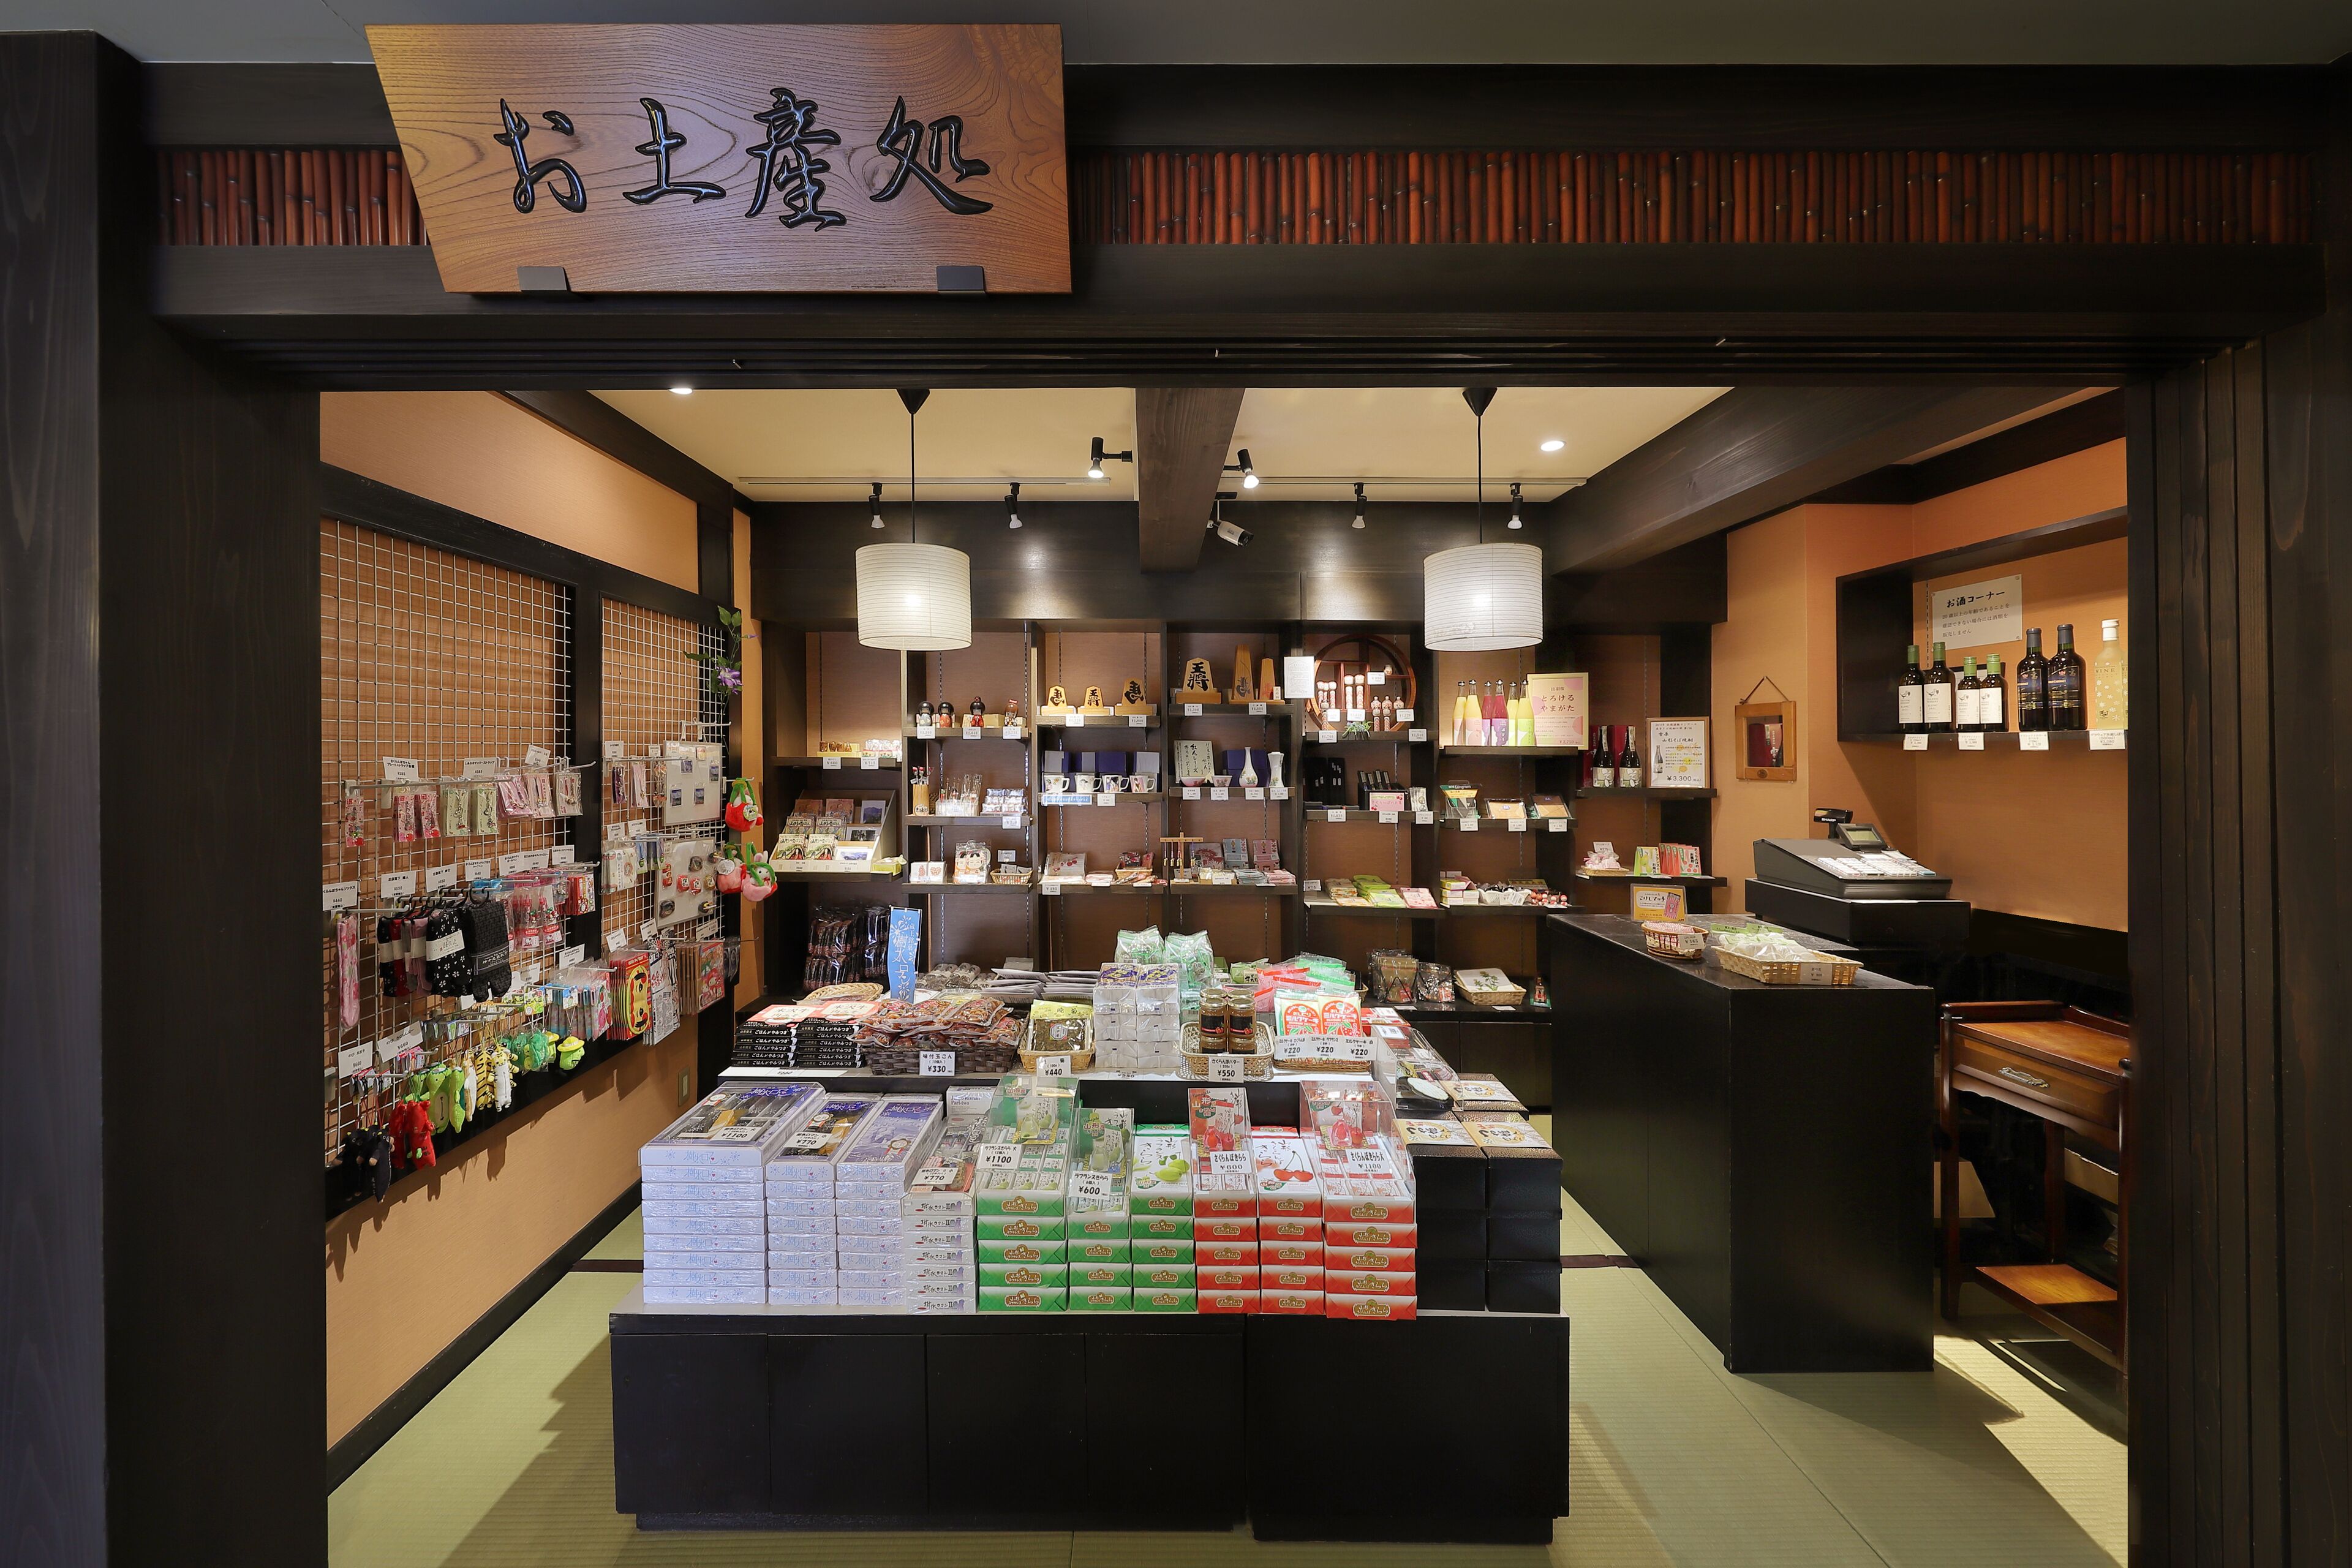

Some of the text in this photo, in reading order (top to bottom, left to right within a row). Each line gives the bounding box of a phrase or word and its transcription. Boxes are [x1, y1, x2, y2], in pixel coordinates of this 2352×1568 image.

[492, 87, 993, 233] お土産処
[1947, 591, 2005, 608] お酒コーナー
[398, 1041, 409, 1050] ¥660
[1214, 1153, 1246, 1163] さくらんぼきらら
[1351, 1152, 1385, 1161] さくらんぼきらら大
[1078, 1186, 1100, 1194] ¥600
[1020, 1226, 1038, 1234] きらら
[1021, 1250, 1039, 1259] きらら
